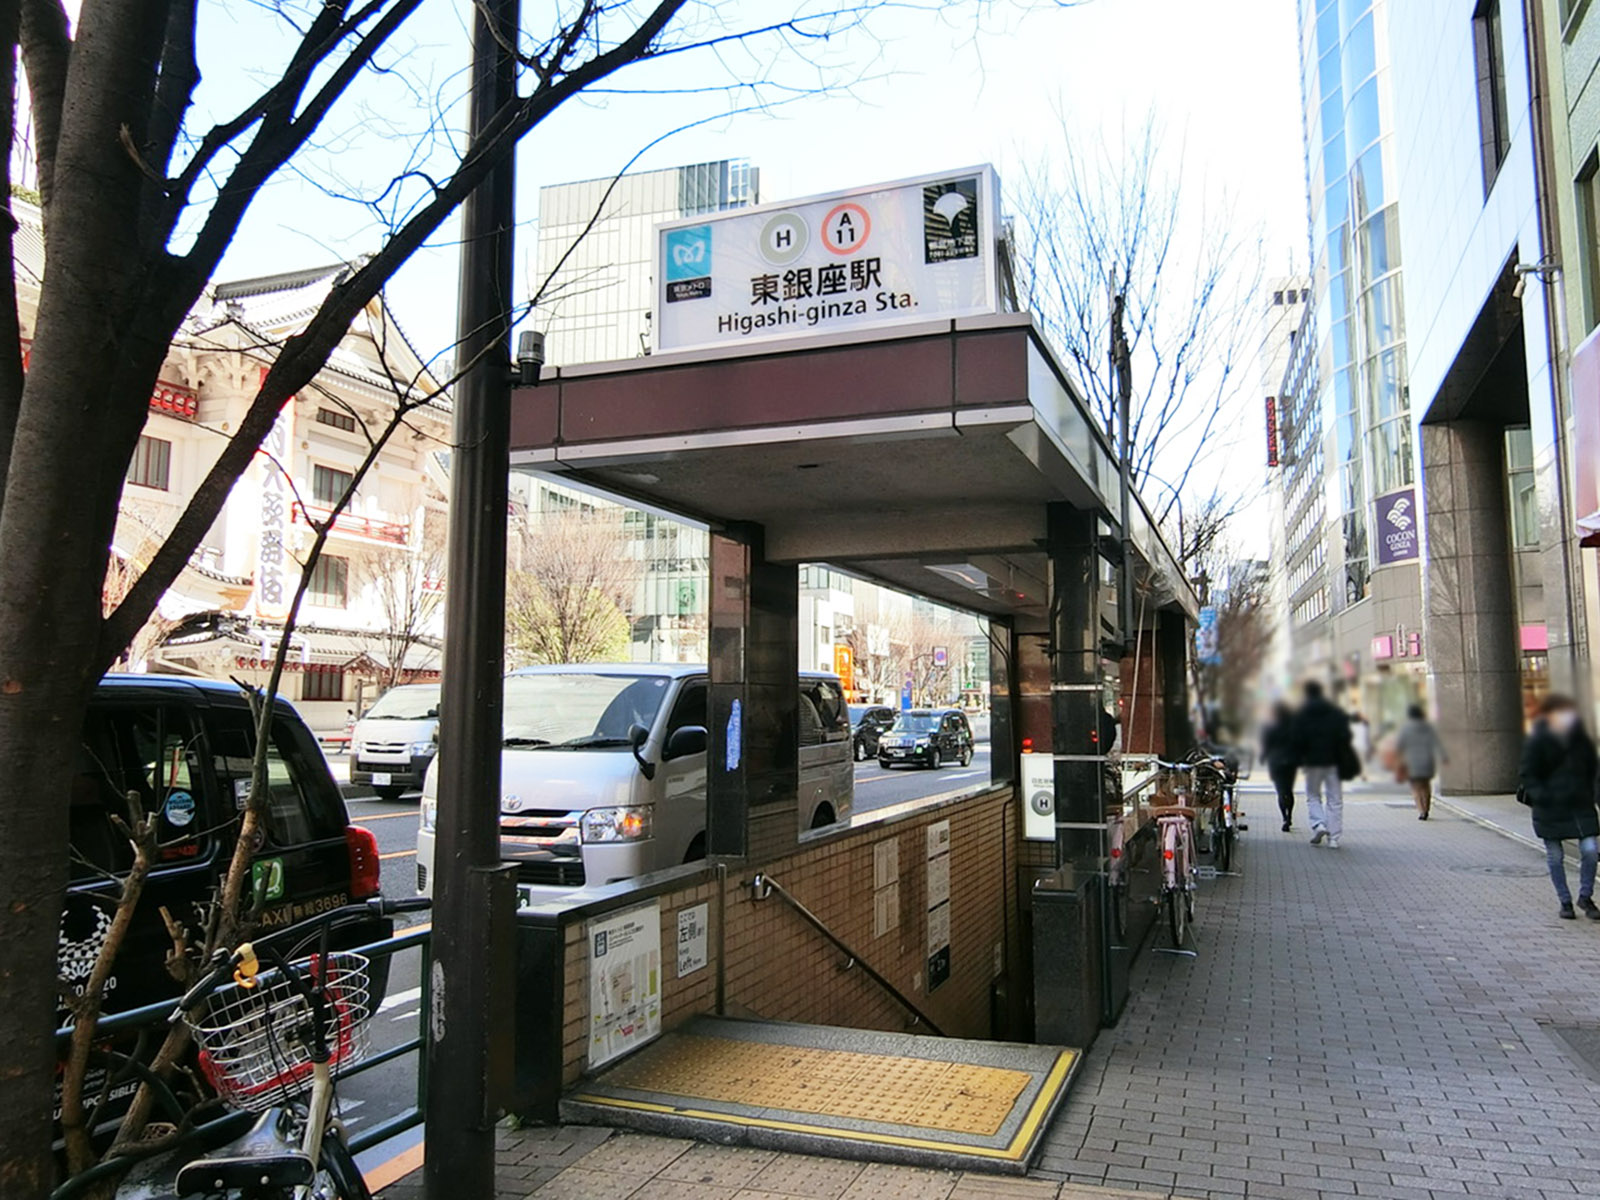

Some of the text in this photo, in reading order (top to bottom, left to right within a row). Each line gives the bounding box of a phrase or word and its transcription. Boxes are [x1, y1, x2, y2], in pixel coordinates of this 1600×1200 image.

[839, 212, 852, 227] A
[775, 230, 792, 249] H
[836, 227, 855, 246] 11
[750, 257, 882, 306] 東銀座駅
[717, 291, 919, 336] Higashi-ginza Sta.
[1386, 530, 1415, 544] COCON
[1040, 799, 1049, 809] H
